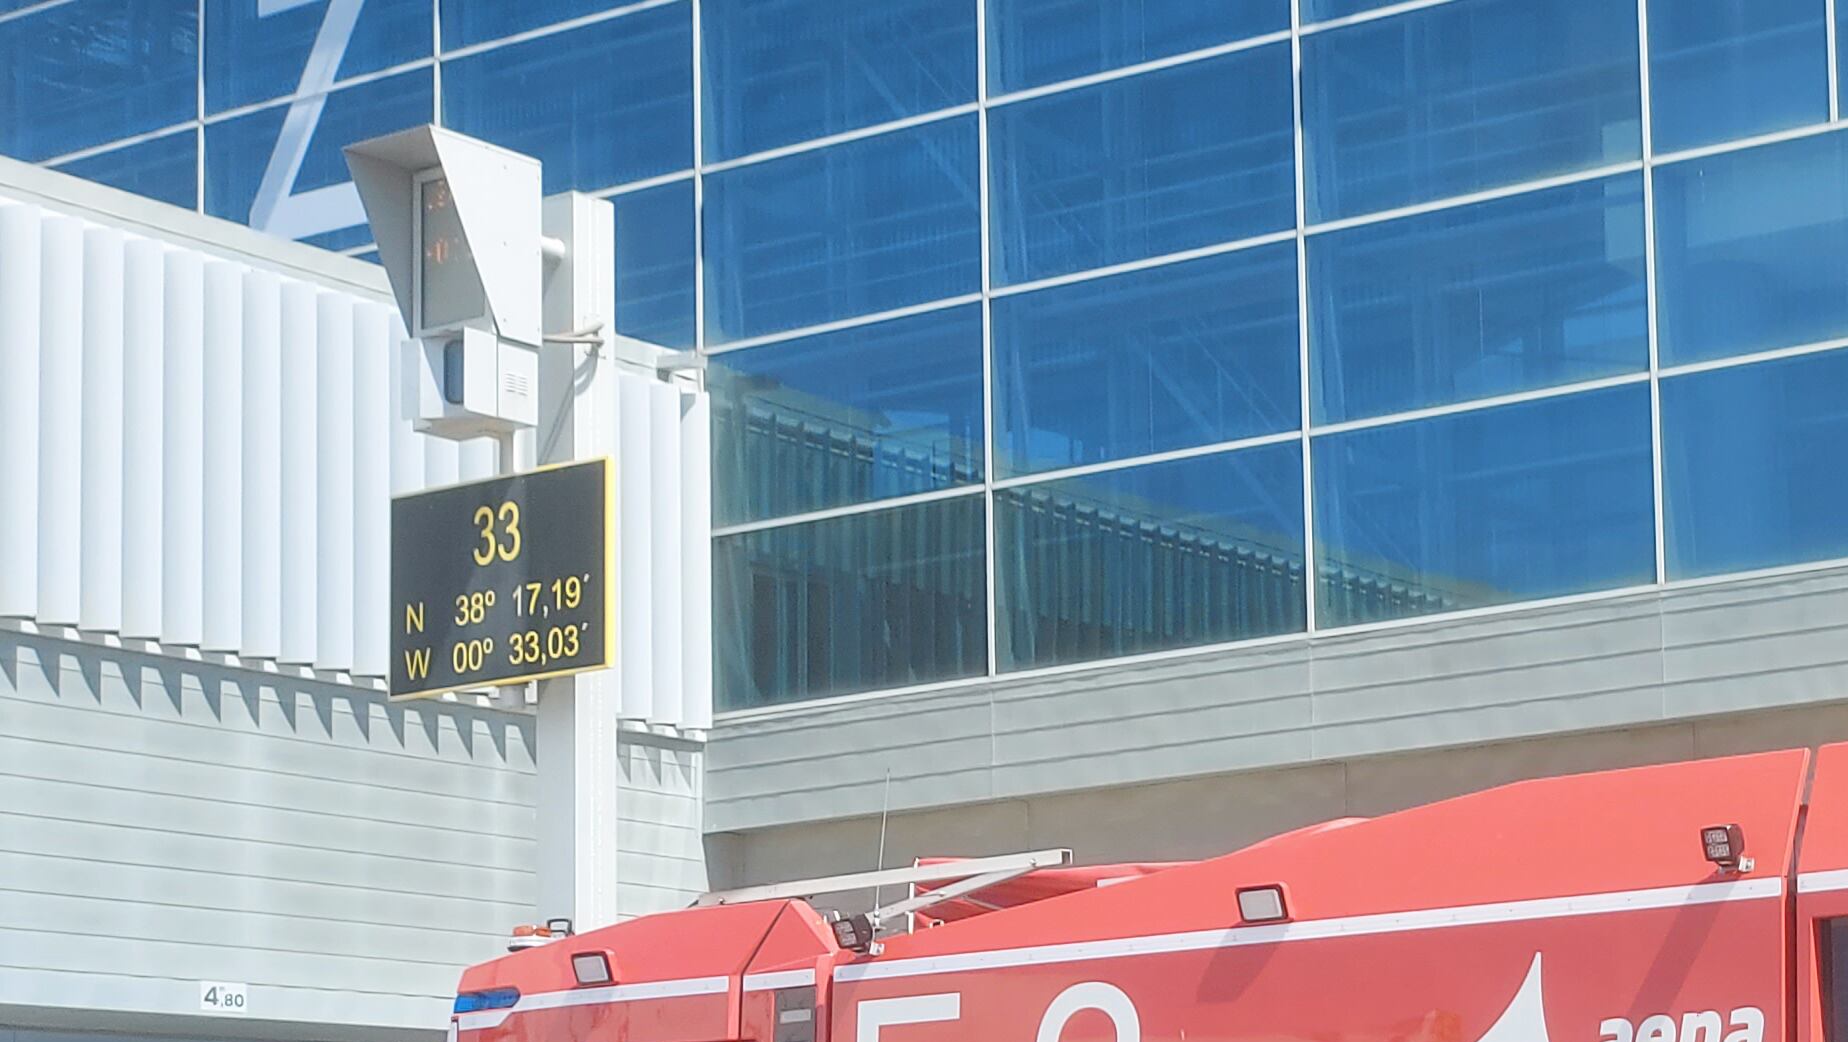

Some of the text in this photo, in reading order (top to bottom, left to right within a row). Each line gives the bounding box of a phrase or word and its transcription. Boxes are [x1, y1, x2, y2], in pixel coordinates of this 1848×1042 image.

[473, 500, 521, 566] 33
[406, 602, 424, 634] N
[405, 647, 431, 680] W
